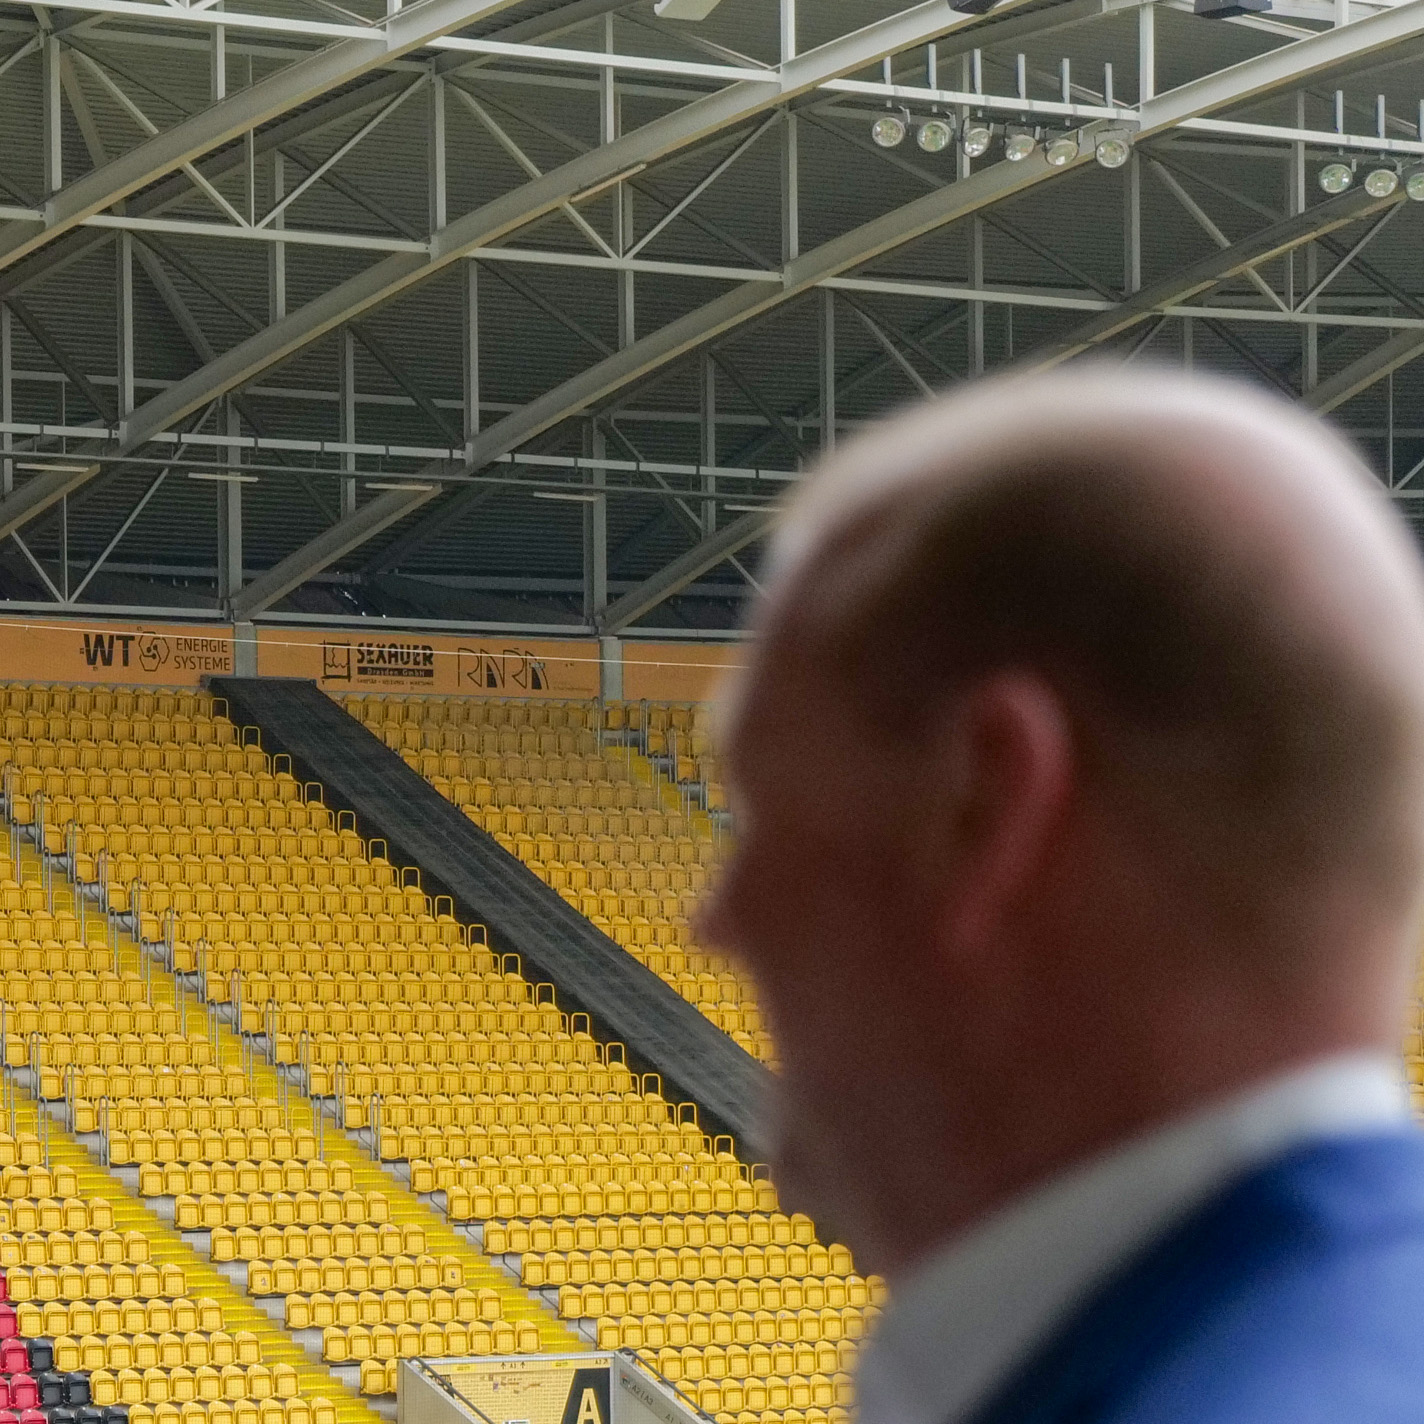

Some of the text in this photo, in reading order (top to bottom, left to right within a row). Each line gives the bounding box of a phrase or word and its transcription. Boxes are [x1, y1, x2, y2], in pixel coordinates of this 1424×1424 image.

[83, 634, 135, 667] WT
[176, 637, 228, 653] ENERGIE
[356, 642, 434, 666] SEXAUER
[173, 655, 230, 671] SYSTEME
